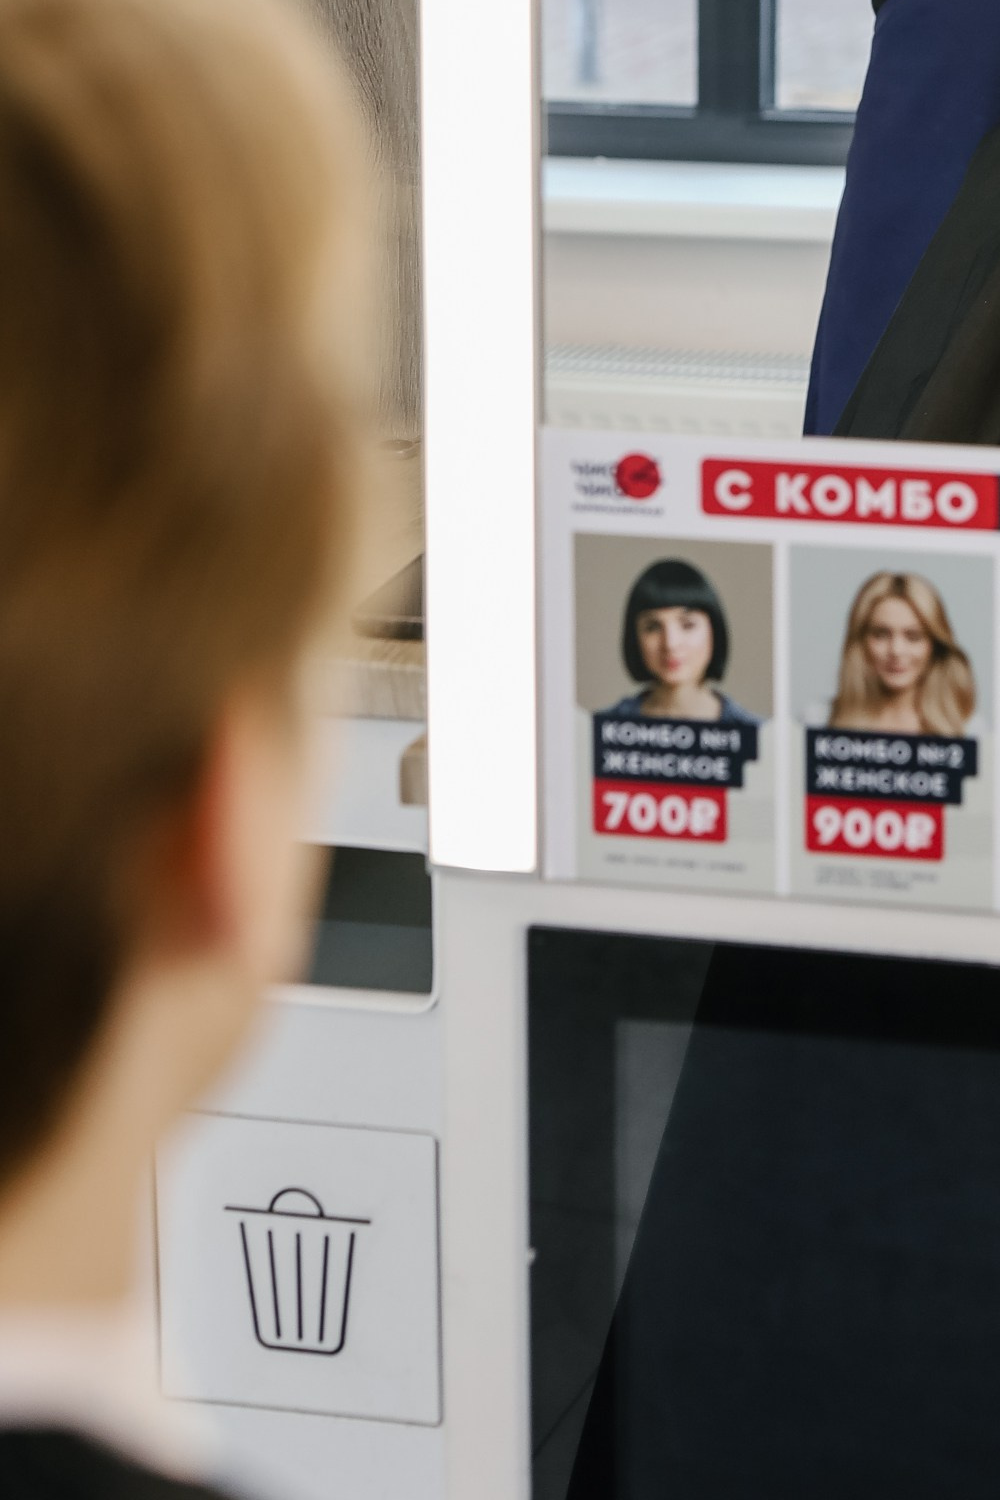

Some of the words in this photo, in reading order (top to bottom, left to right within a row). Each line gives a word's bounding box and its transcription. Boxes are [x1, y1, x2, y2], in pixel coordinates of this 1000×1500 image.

[714, 469, 753, 511] С
[776, 474, 979, 523] КОМБО
[602, 723, 695, 750] КОМБО
[815, 737, 910, 765] КОМБО
[602, 750, 731, 782] ЖЕНСКОЕ
[816, 766, 948, 797] ЖЕНСКОЕ
